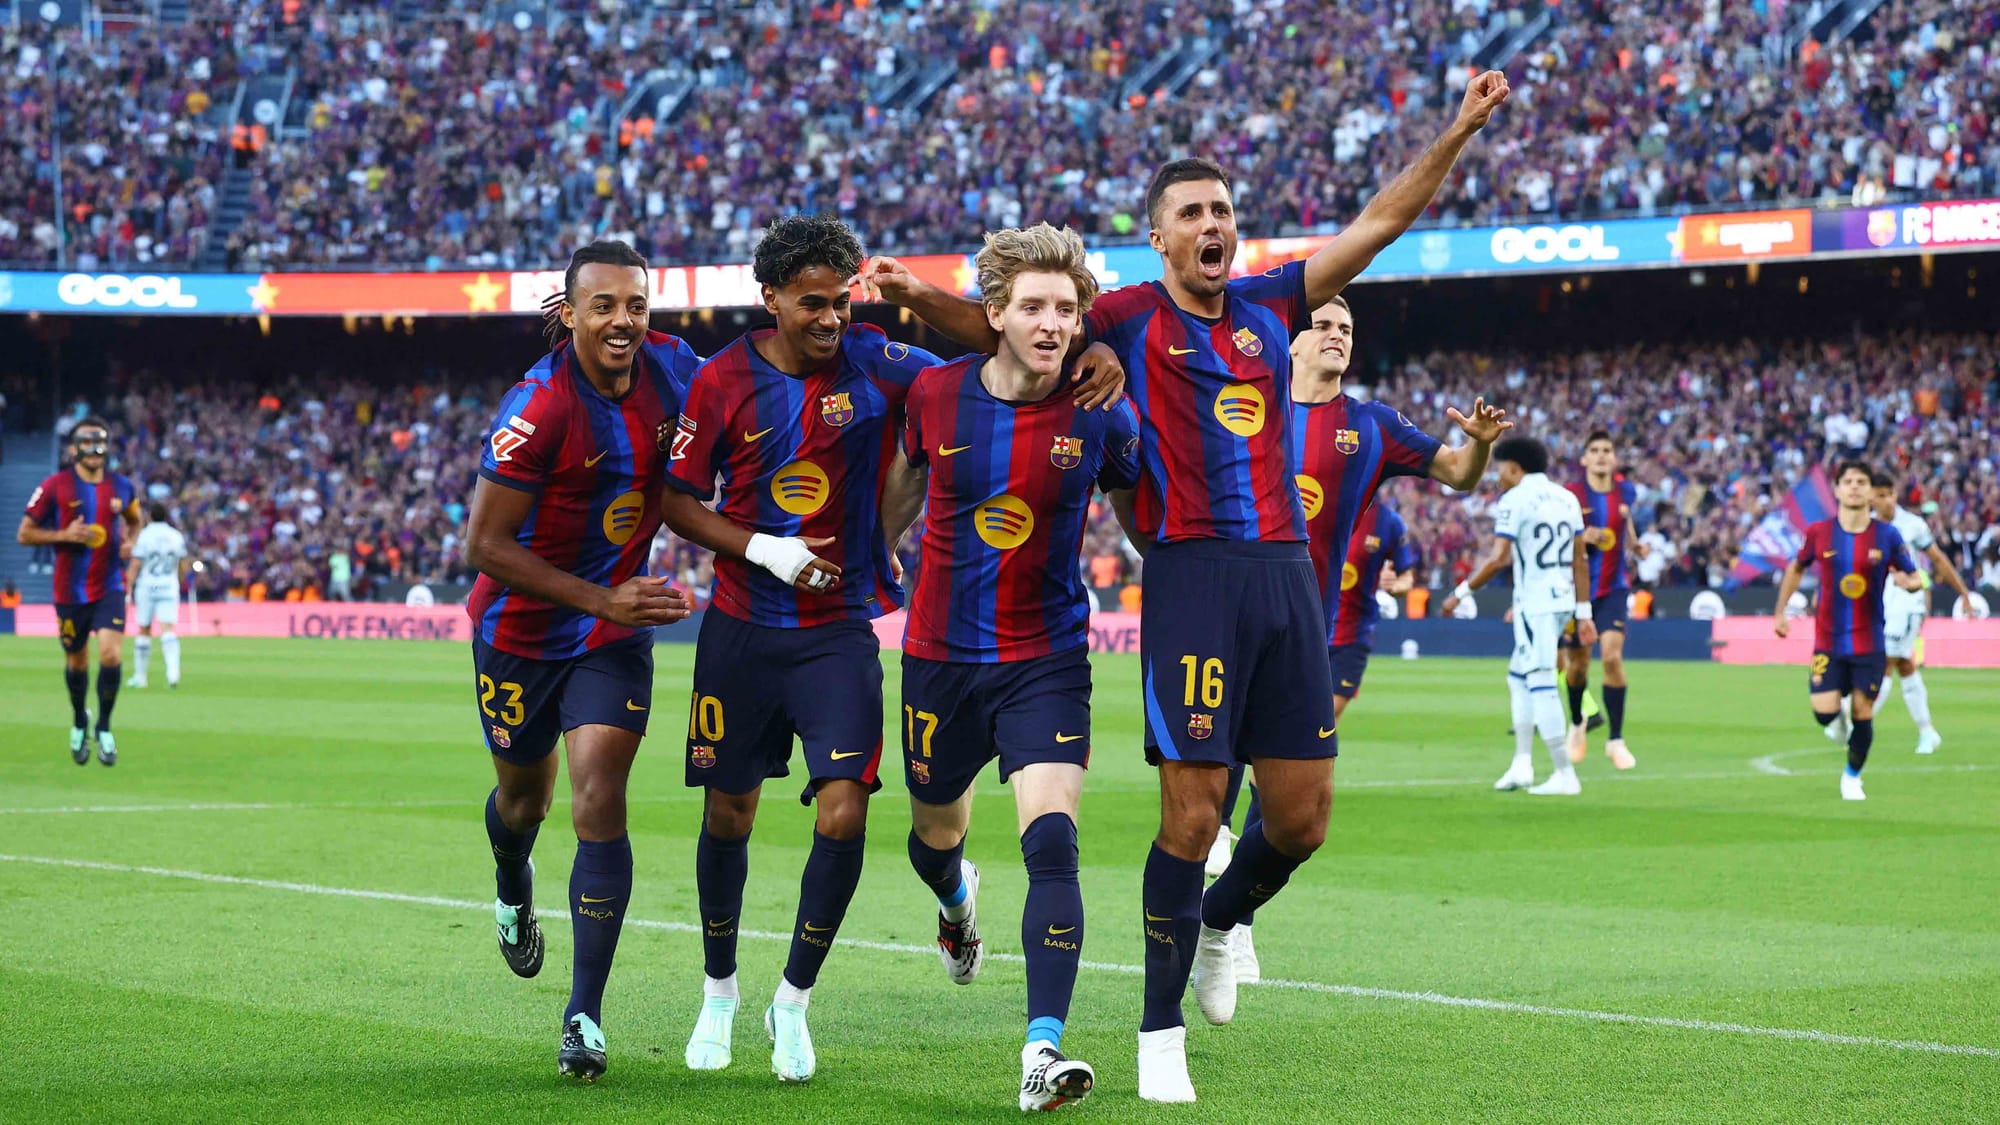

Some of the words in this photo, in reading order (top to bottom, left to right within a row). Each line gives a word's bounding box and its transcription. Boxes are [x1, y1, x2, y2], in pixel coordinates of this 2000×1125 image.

[1491, 225, 1619, 263] GOOL
[58, 273, 197, 307] GOOL
[1534, 521, 1573, 569] 22
[289, 615, 357, 639] LOVE
[363, 616, 457, 640] ENGINE
[1088, 628, 1138, 652] OVE
[479, 673, 525, 726] 23
[1180, 654, 1225, 708] 16
[689, 691, 725, 741] 10
[905, 704, 939, 757] 17
[578, 905, 614, 921] BARÇA
[1043, 937, 1077, 951] BARÇA
